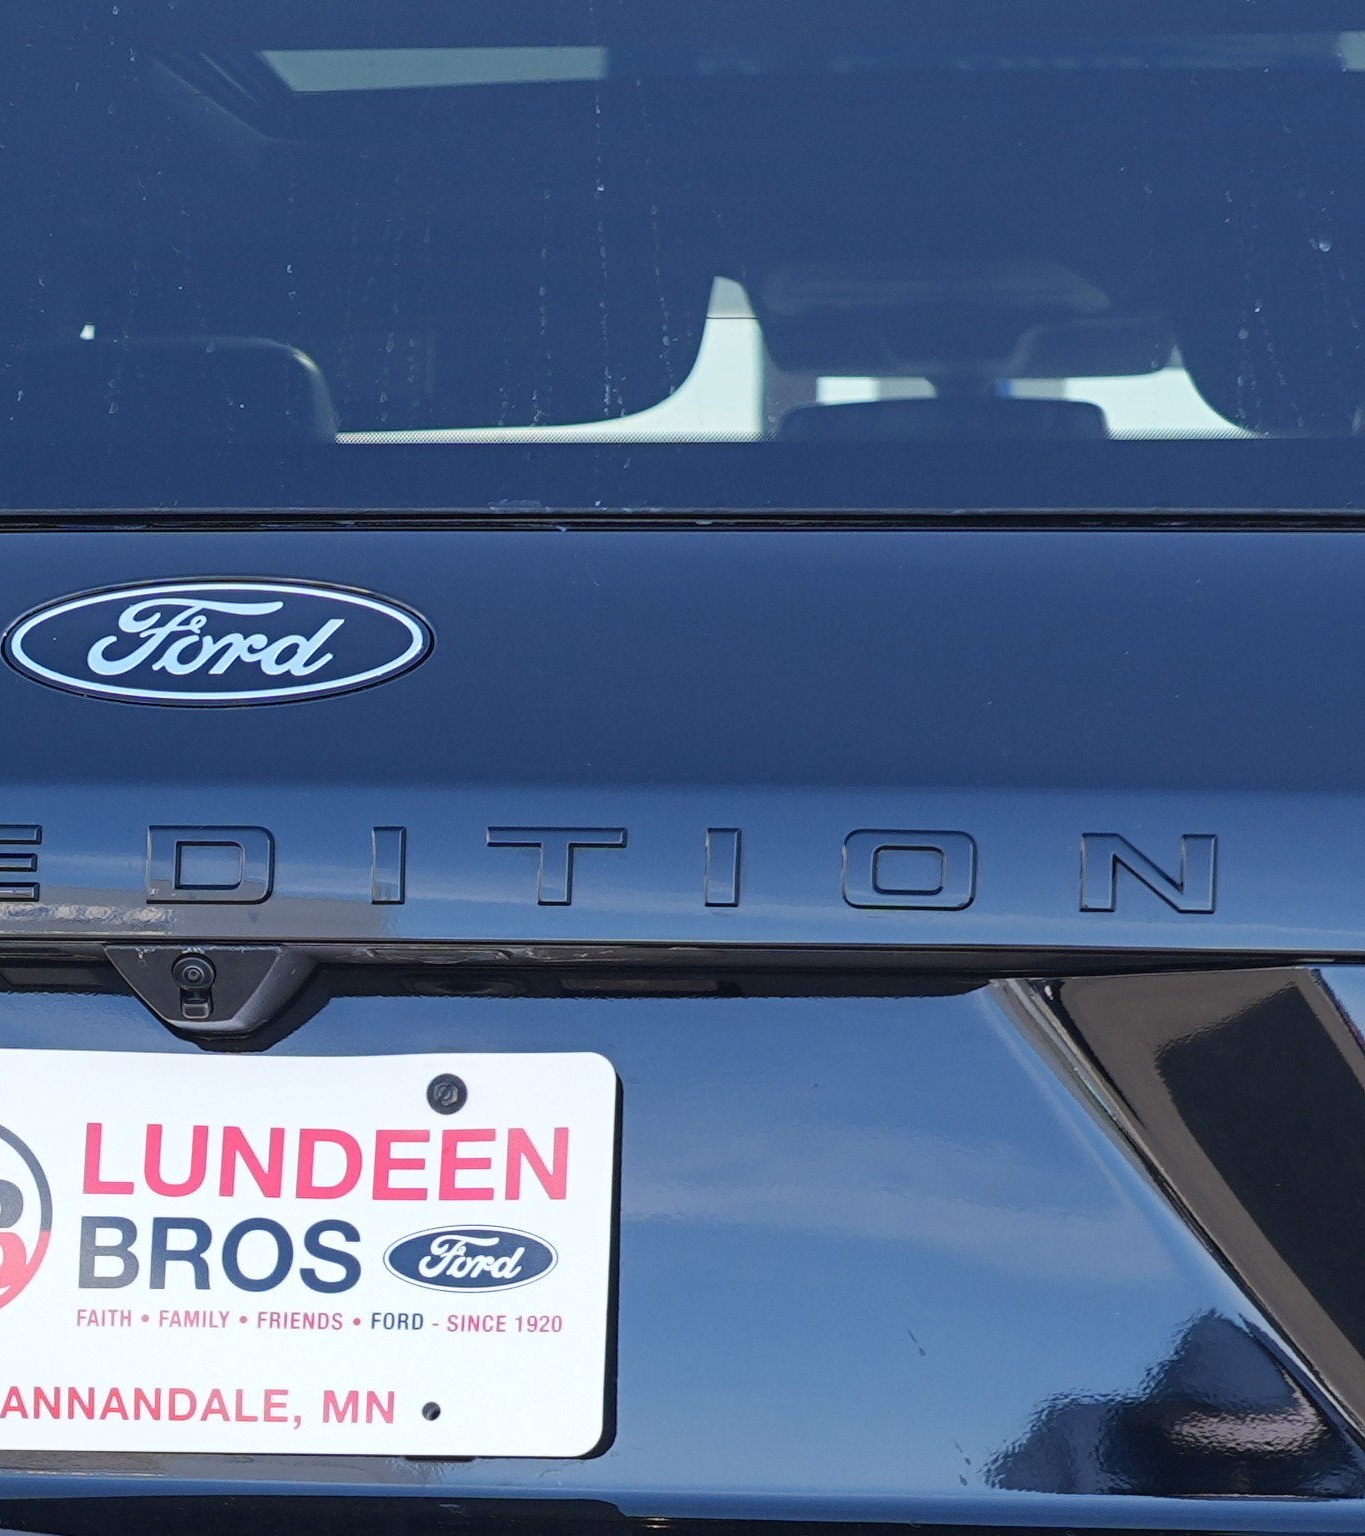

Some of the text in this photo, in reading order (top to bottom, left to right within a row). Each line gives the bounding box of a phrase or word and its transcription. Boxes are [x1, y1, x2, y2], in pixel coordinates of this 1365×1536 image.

[87, 597, 346, 677] Ford
[82, 1121, 570, 1202] LUNDEEN
[77, 1215, 362, 1295] BROS
[418, 1234, 526, 1280] Ford
[76, 1308, 564, 1334] FAITH FAMILY FRIENDS FORD SINCE 1920
[322, 1389, 396, 1425] MN
